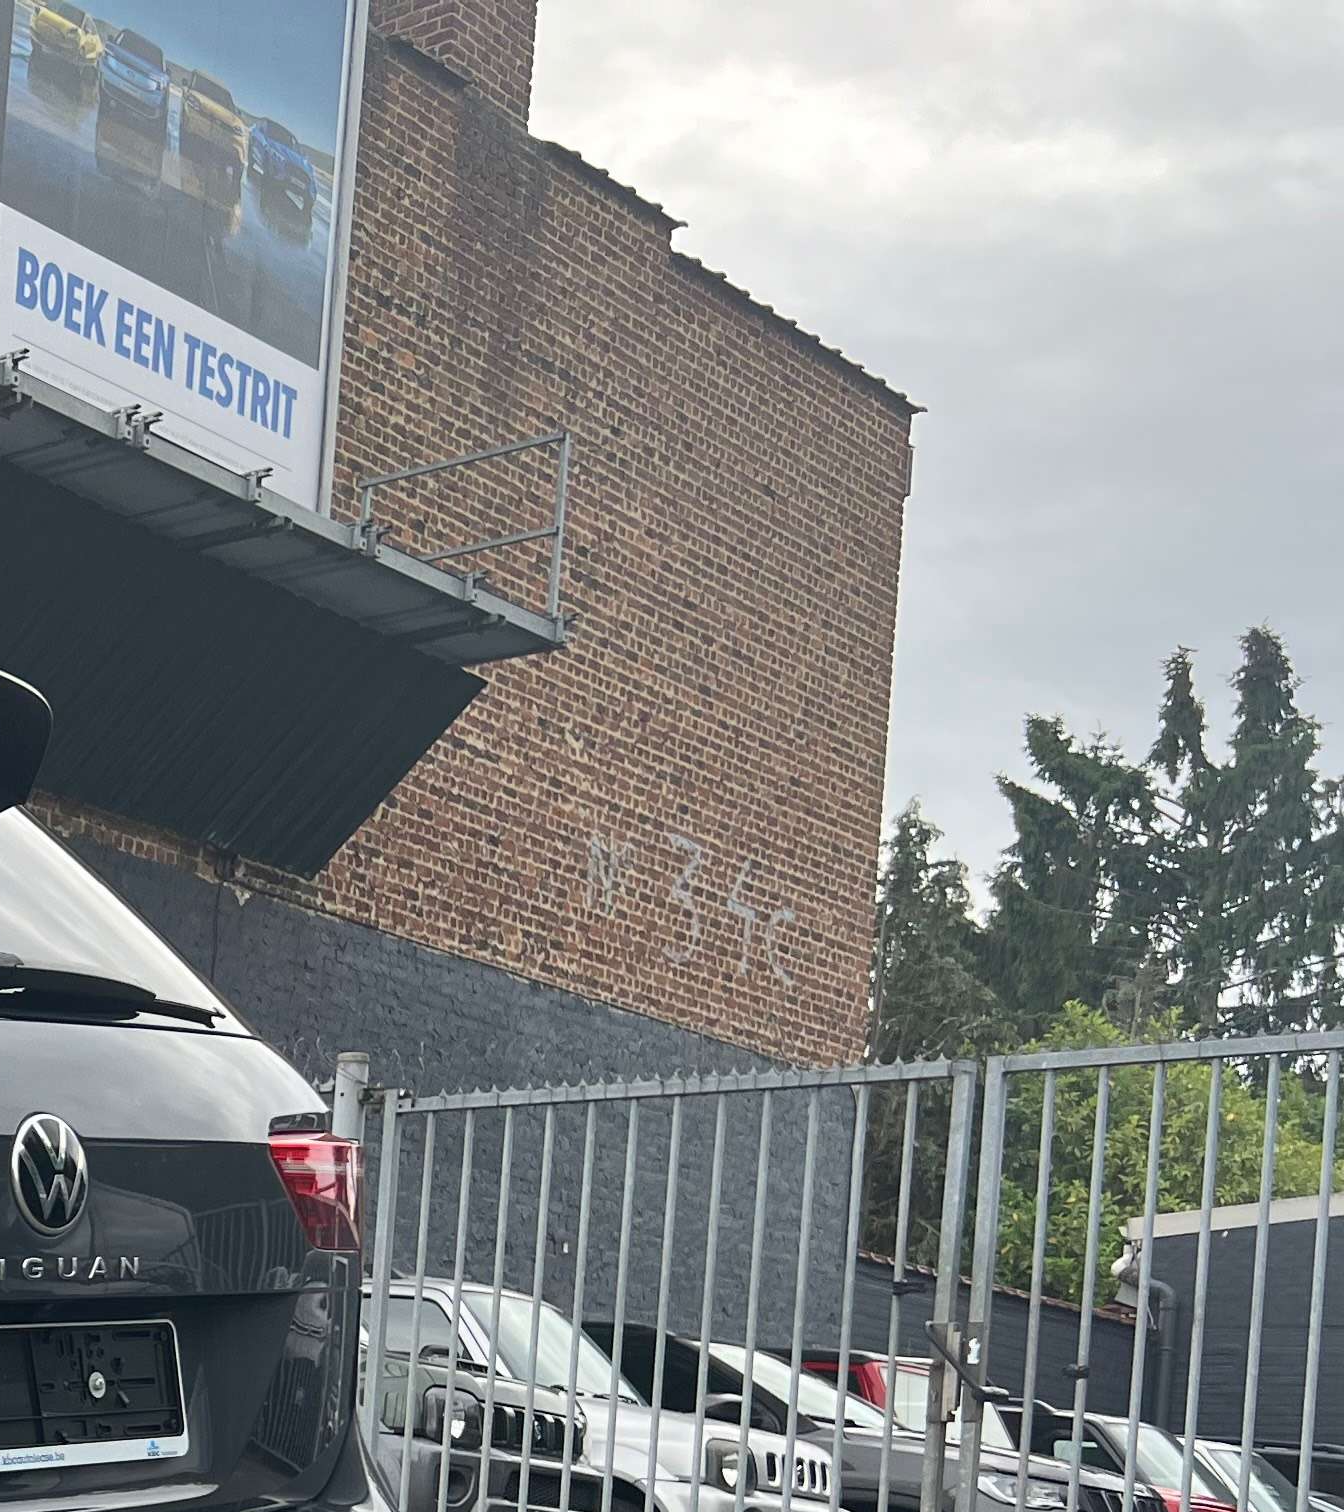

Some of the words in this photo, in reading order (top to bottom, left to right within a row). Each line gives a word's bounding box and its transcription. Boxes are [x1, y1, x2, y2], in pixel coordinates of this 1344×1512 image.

[15, 246, 109, 347] BOEK
[115, 297, 177, 381] EEN
[184, 332, 298, 440] TESTRIT
